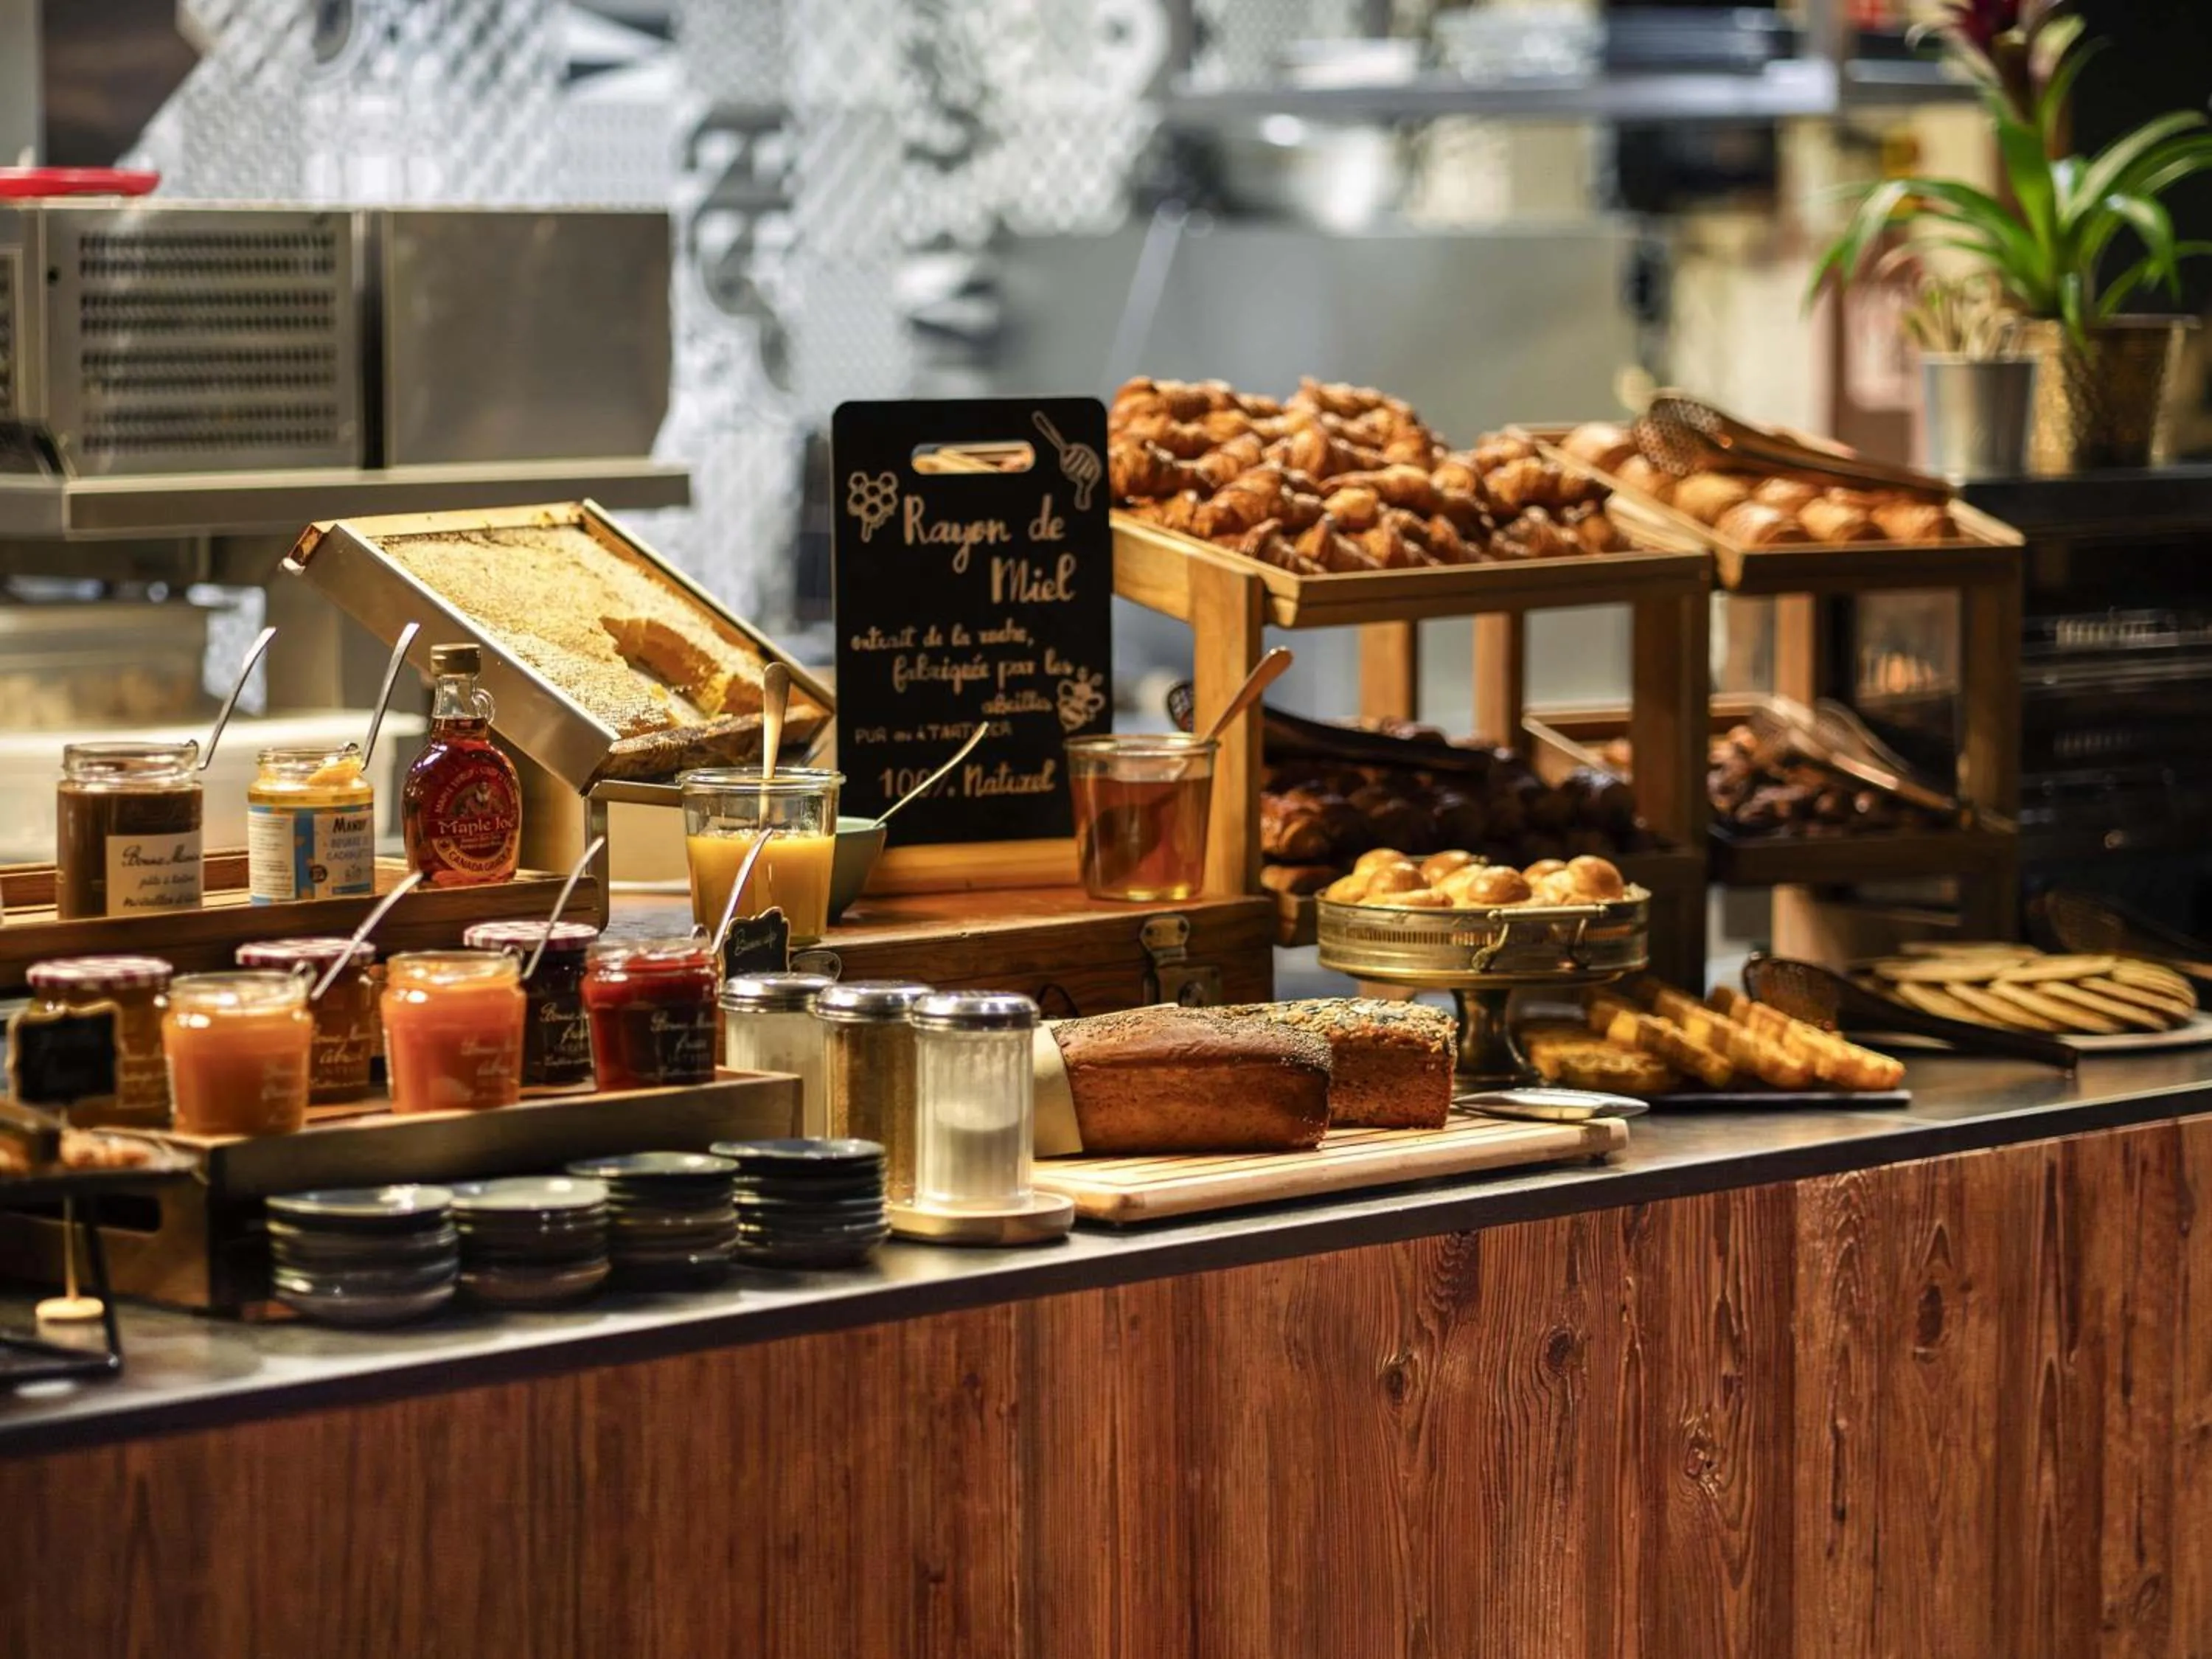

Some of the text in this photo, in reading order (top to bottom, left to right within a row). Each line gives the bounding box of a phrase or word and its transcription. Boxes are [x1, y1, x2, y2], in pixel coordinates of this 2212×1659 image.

[902, 493, 1066, 574] Rayon de
[990, 552, 1077, 605] Miel
[922, 625, 943, 647] de
[951, 623, 971, 647] la
[997, 661, 1036, 690] par
[854, 726, 889, 744] PUR
[438, 818, 492, 837] Maple
